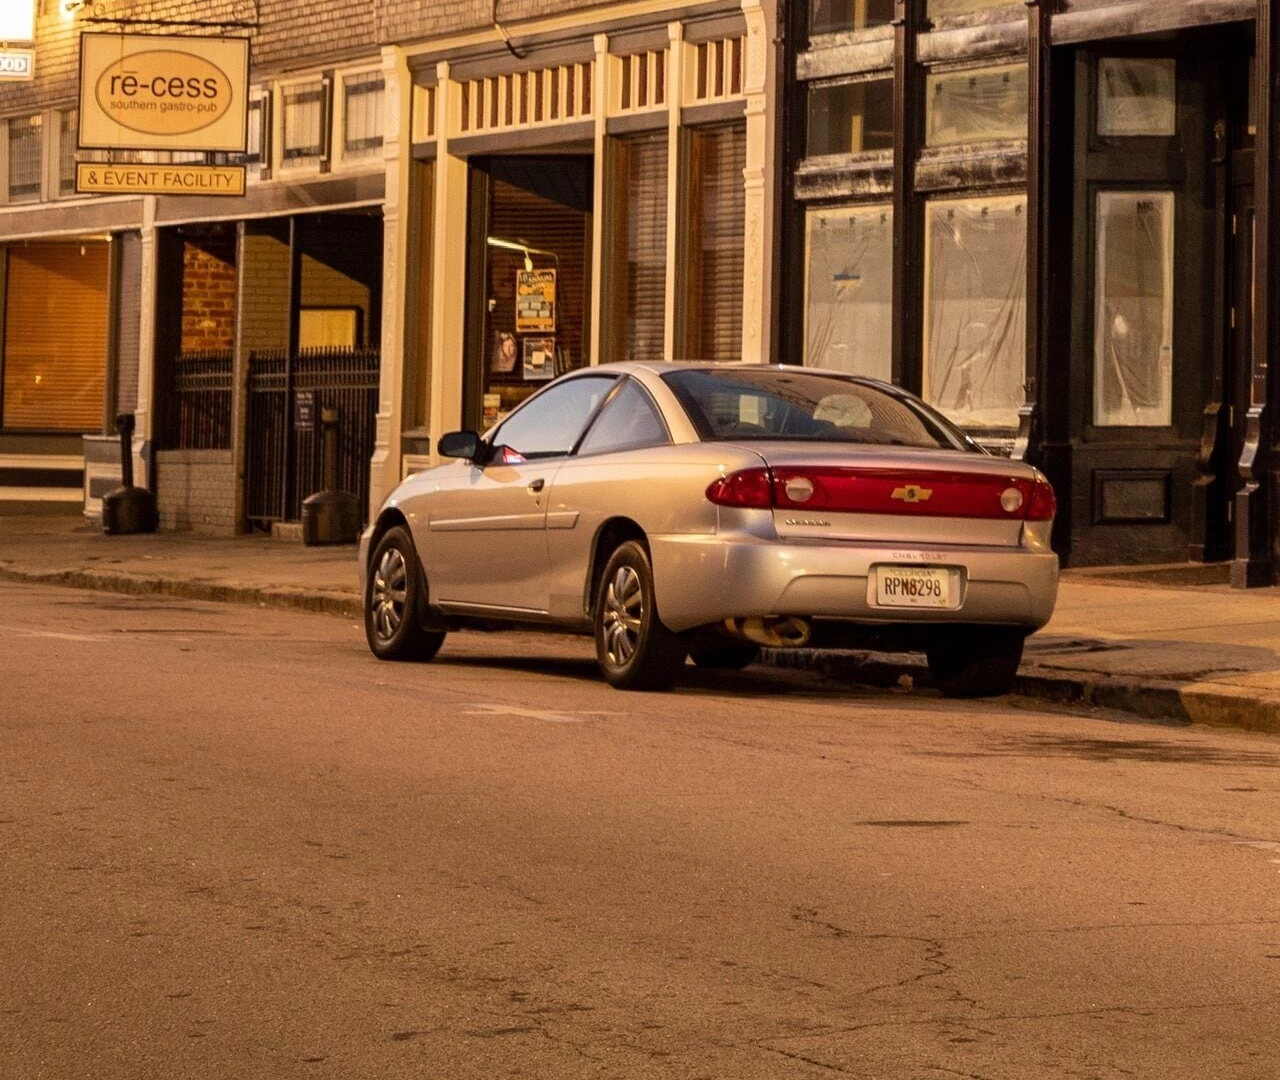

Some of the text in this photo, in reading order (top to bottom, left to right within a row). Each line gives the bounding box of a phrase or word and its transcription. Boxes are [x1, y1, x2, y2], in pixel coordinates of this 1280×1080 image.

[110, 100, 218, 113] southern gastro-pub
[87, 171, 234, 187] & EVENT FACILITY
[892, 552, 948, 561] CHEVROLET
